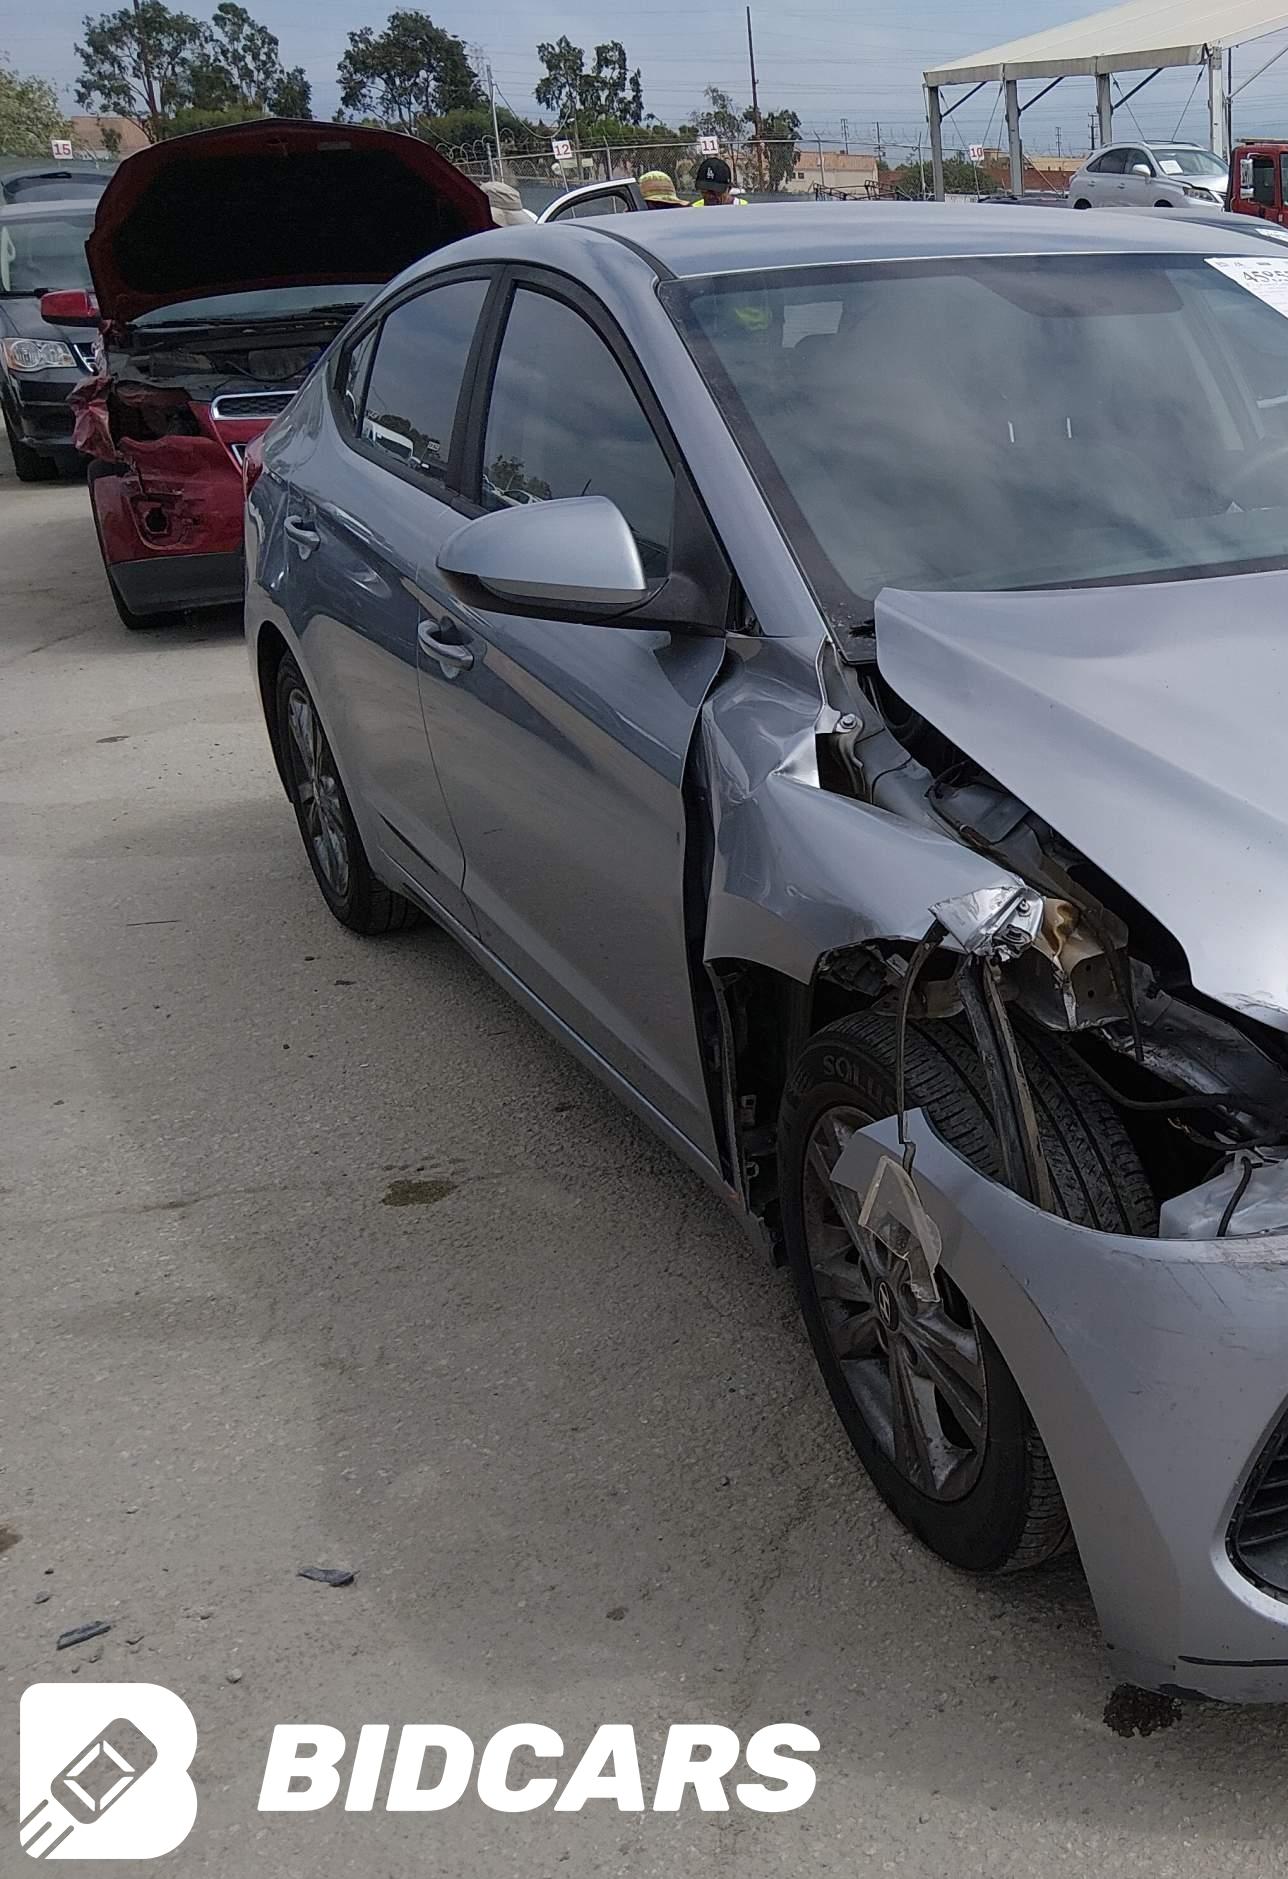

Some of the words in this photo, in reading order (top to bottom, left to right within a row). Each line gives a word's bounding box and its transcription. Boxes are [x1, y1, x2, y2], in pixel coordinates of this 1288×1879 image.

[54, 144, 71, 155] 15
[555, 143, 571, 156] 12
[702, 140, 717, 150] 11
[971, 147, 982, 157] 10
